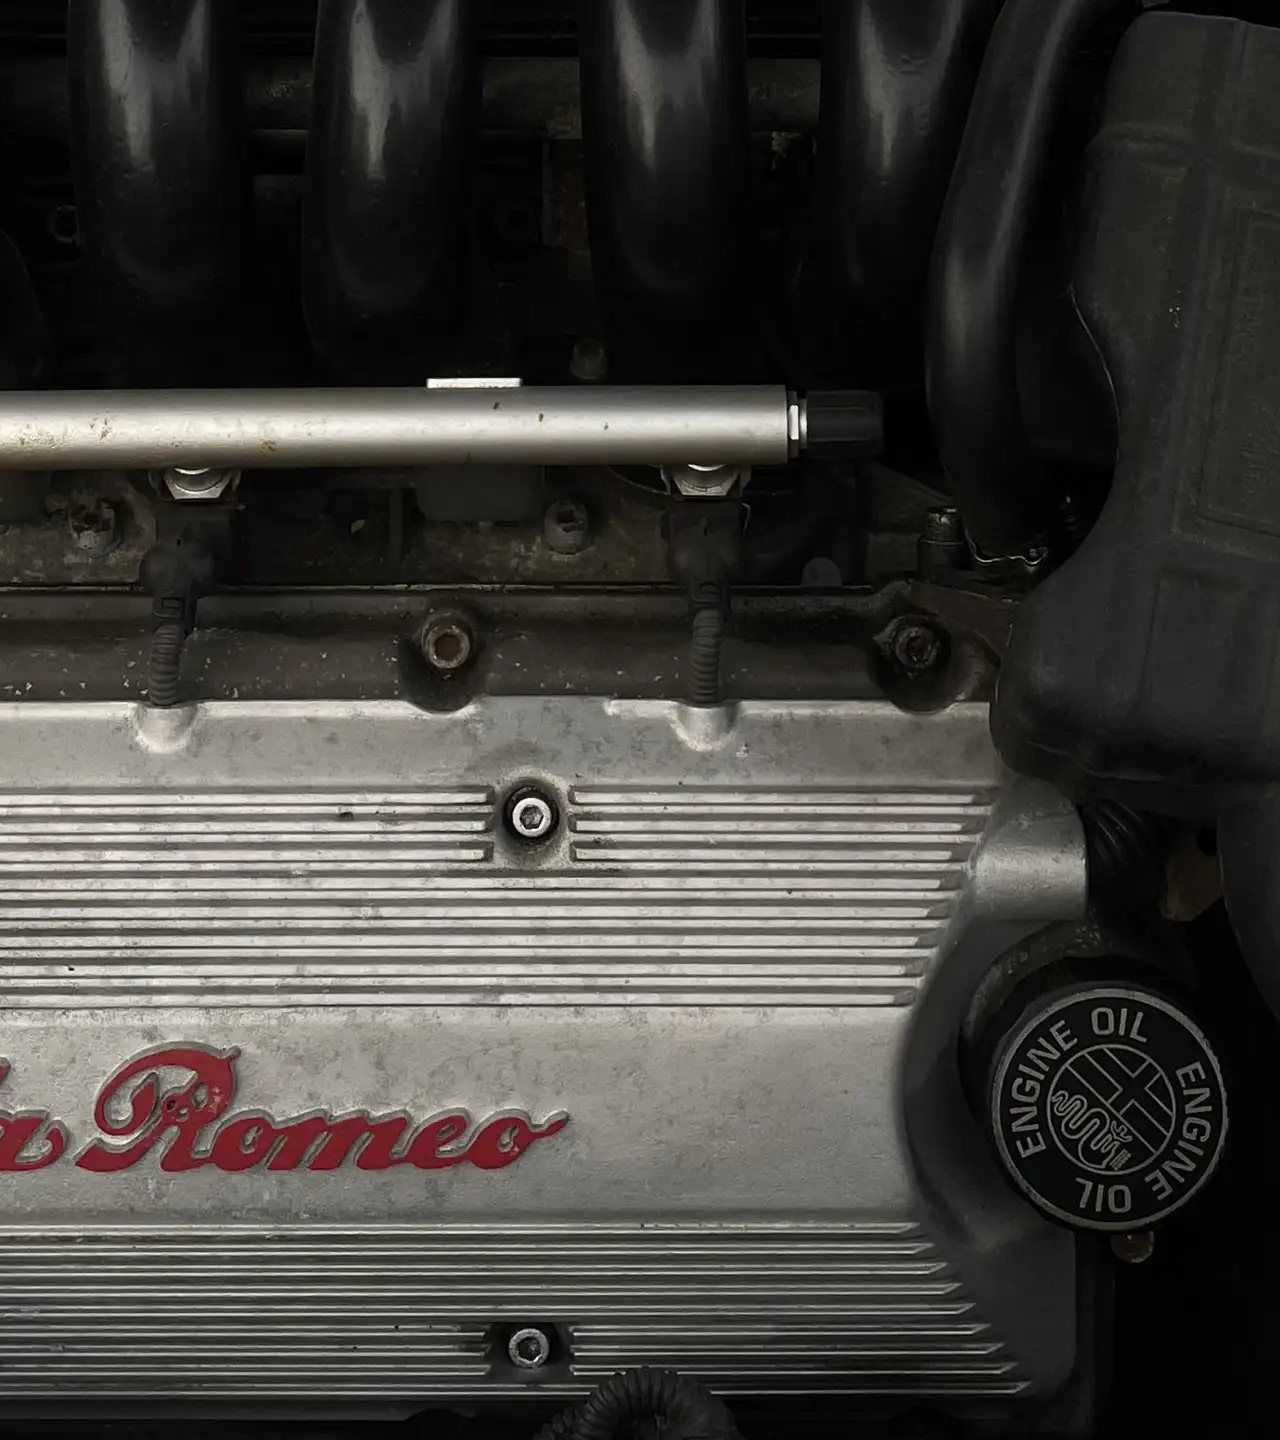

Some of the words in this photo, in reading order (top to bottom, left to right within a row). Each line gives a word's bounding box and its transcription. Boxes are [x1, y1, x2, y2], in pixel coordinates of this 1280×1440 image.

[74, 1042, 570, 1172] Romeo
[1009, 1019, 1078, 1159] ENGINE
[1091, 1007, 1149, 1044] OIL
[1144, 1061, 1212, 1201] ENGINE
[1076, 1177, 1132, 1213] OIL
